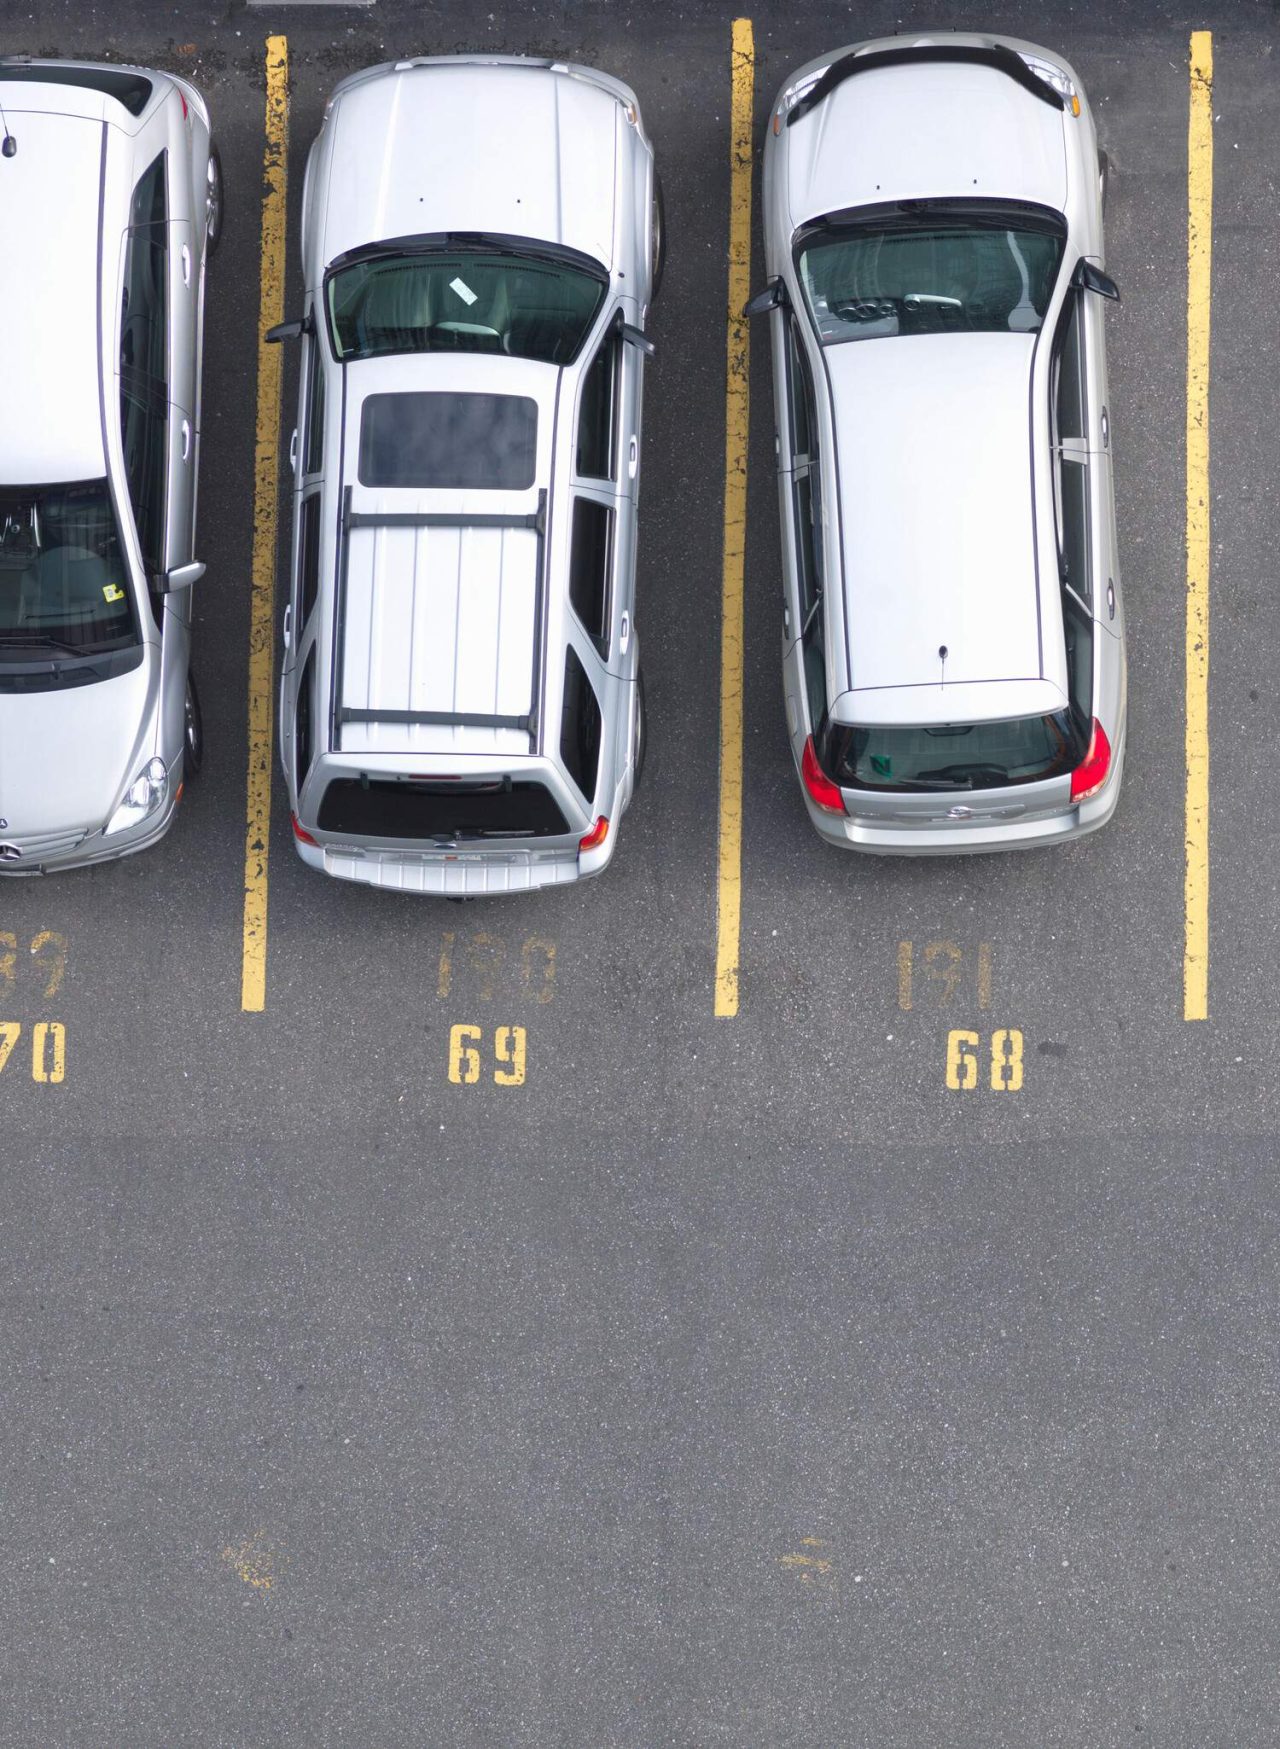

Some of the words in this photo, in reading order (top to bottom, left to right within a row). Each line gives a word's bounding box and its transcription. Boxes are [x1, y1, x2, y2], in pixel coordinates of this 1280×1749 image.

[898, 940, 991, 1010] 191
[448, 1024, 526, 1085] 69
[946, 1030, 1023, 1090] 68
